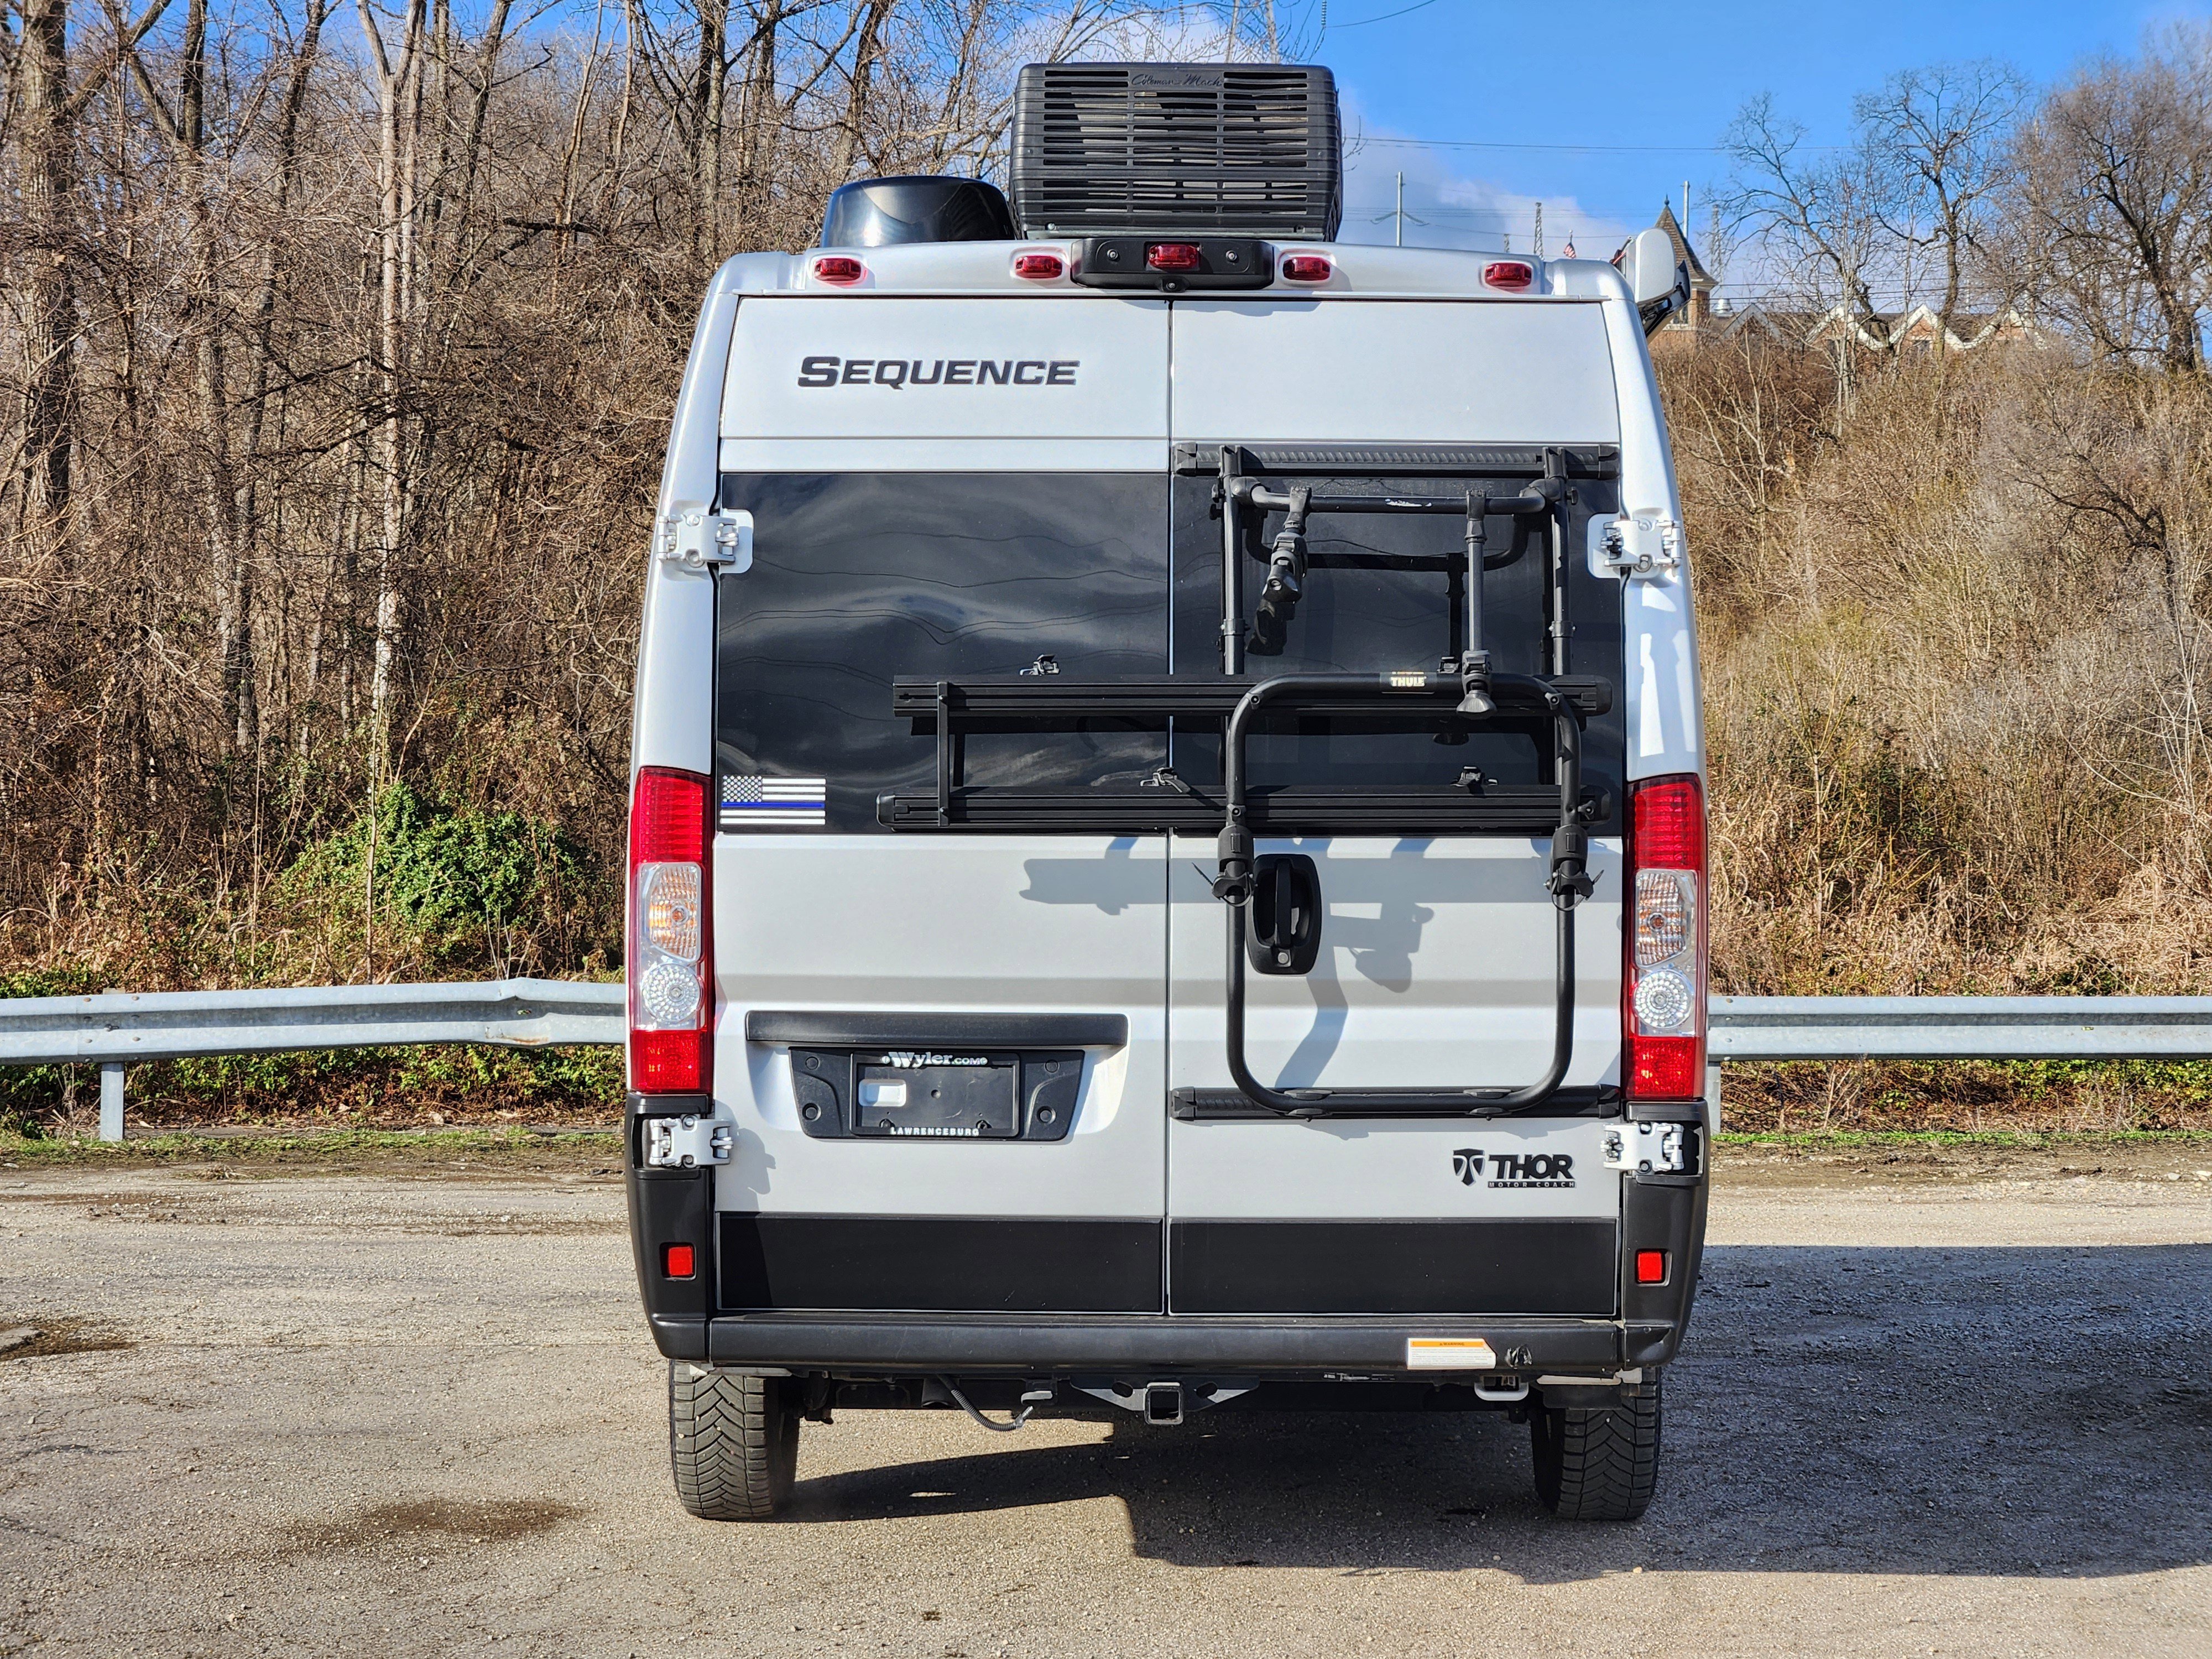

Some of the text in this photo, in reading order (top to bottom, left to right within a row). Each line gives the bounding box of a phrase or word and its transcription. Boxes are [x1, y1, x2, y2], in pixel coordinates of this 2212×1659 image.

[797, 356, 1081, 390] SEQUENCE
[1390, 676, 1426, 687] THULE
[890, 1126, 979, 1136] LAWRENCEBURG
[1488, 1154, 1575, 1179] THOR
